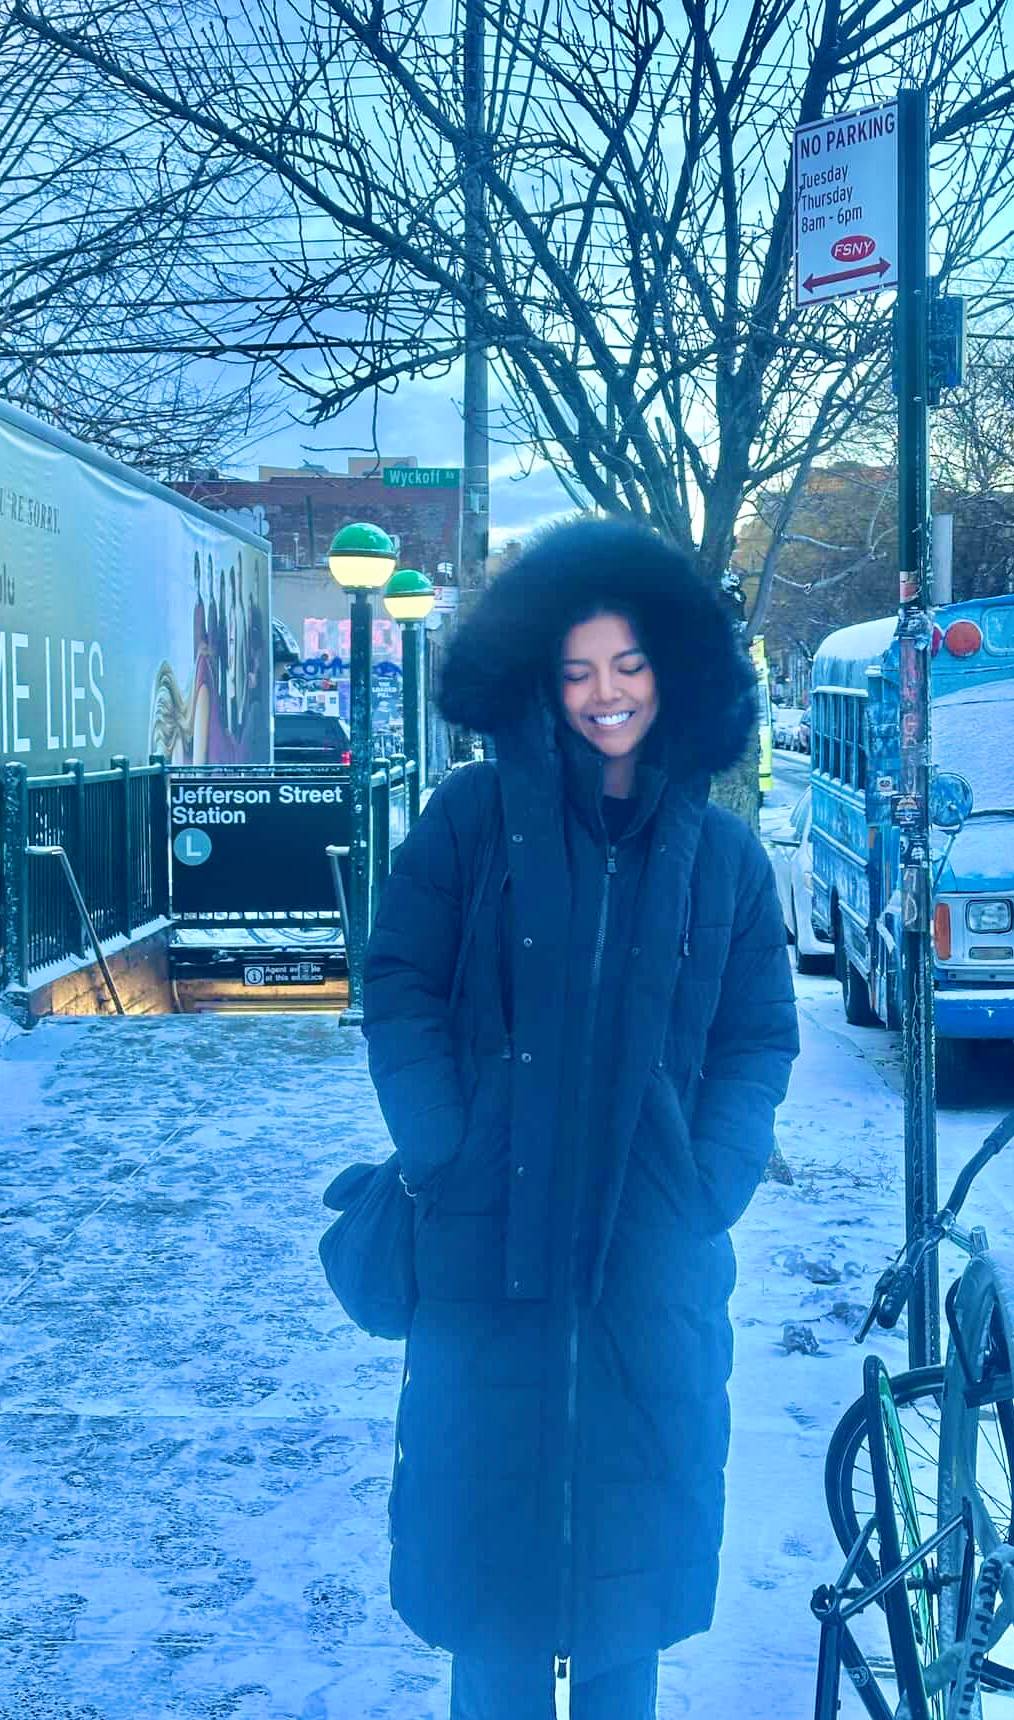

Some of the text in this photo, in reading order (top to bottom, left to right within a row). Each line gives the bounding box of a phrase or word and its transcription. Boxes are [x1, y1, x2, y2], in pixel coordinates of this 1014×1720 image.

[800, 113, 895, 159] NO PARKING
[801, 165, 848, 188] Tuesday
[801, 186, 853, 211] Thursday
[801, 213, 825, 233] 8am
[837, 206, 863, 226] 6pm
[834, 241, 873, 257] FSNY
[389, 469, 440, 487] Wyckoff
[45, 636, 105, 751] LIES
[172, 785, 343, 804] Jefferson Street
[172, 806, 246, 824] Station
[186, 835, 202, 857] L
